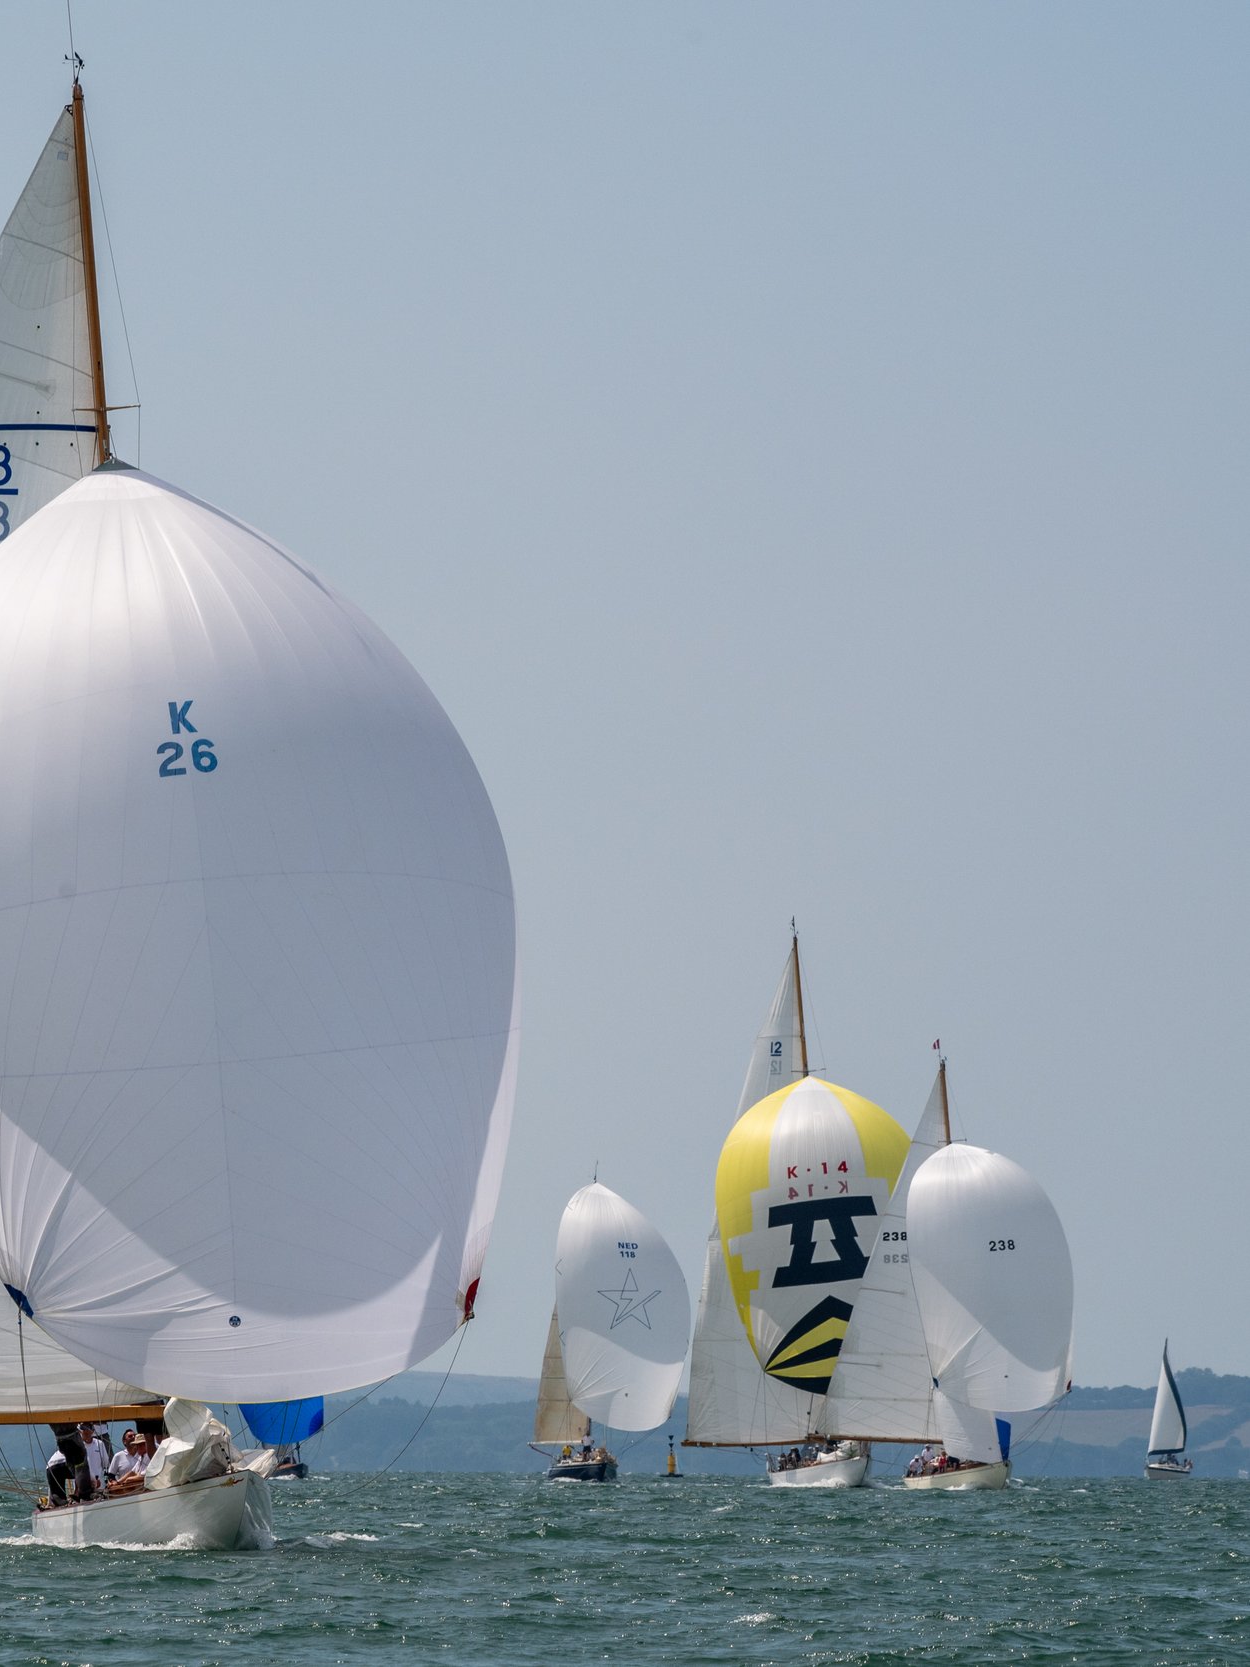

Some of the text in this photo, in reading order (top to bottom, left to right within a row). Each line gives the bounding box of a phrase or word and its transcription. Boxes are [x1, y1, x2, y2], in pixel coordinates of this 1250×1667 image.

[168, 700, 198, 734] K
[157, 739, 218, 777] 26
[770, 1041, 782, 1054] 12
[882, 1232, 908, 1242] 238
[617, 1241, 639, 1250] NED
[989, 1239, 1016, 1252] 238
